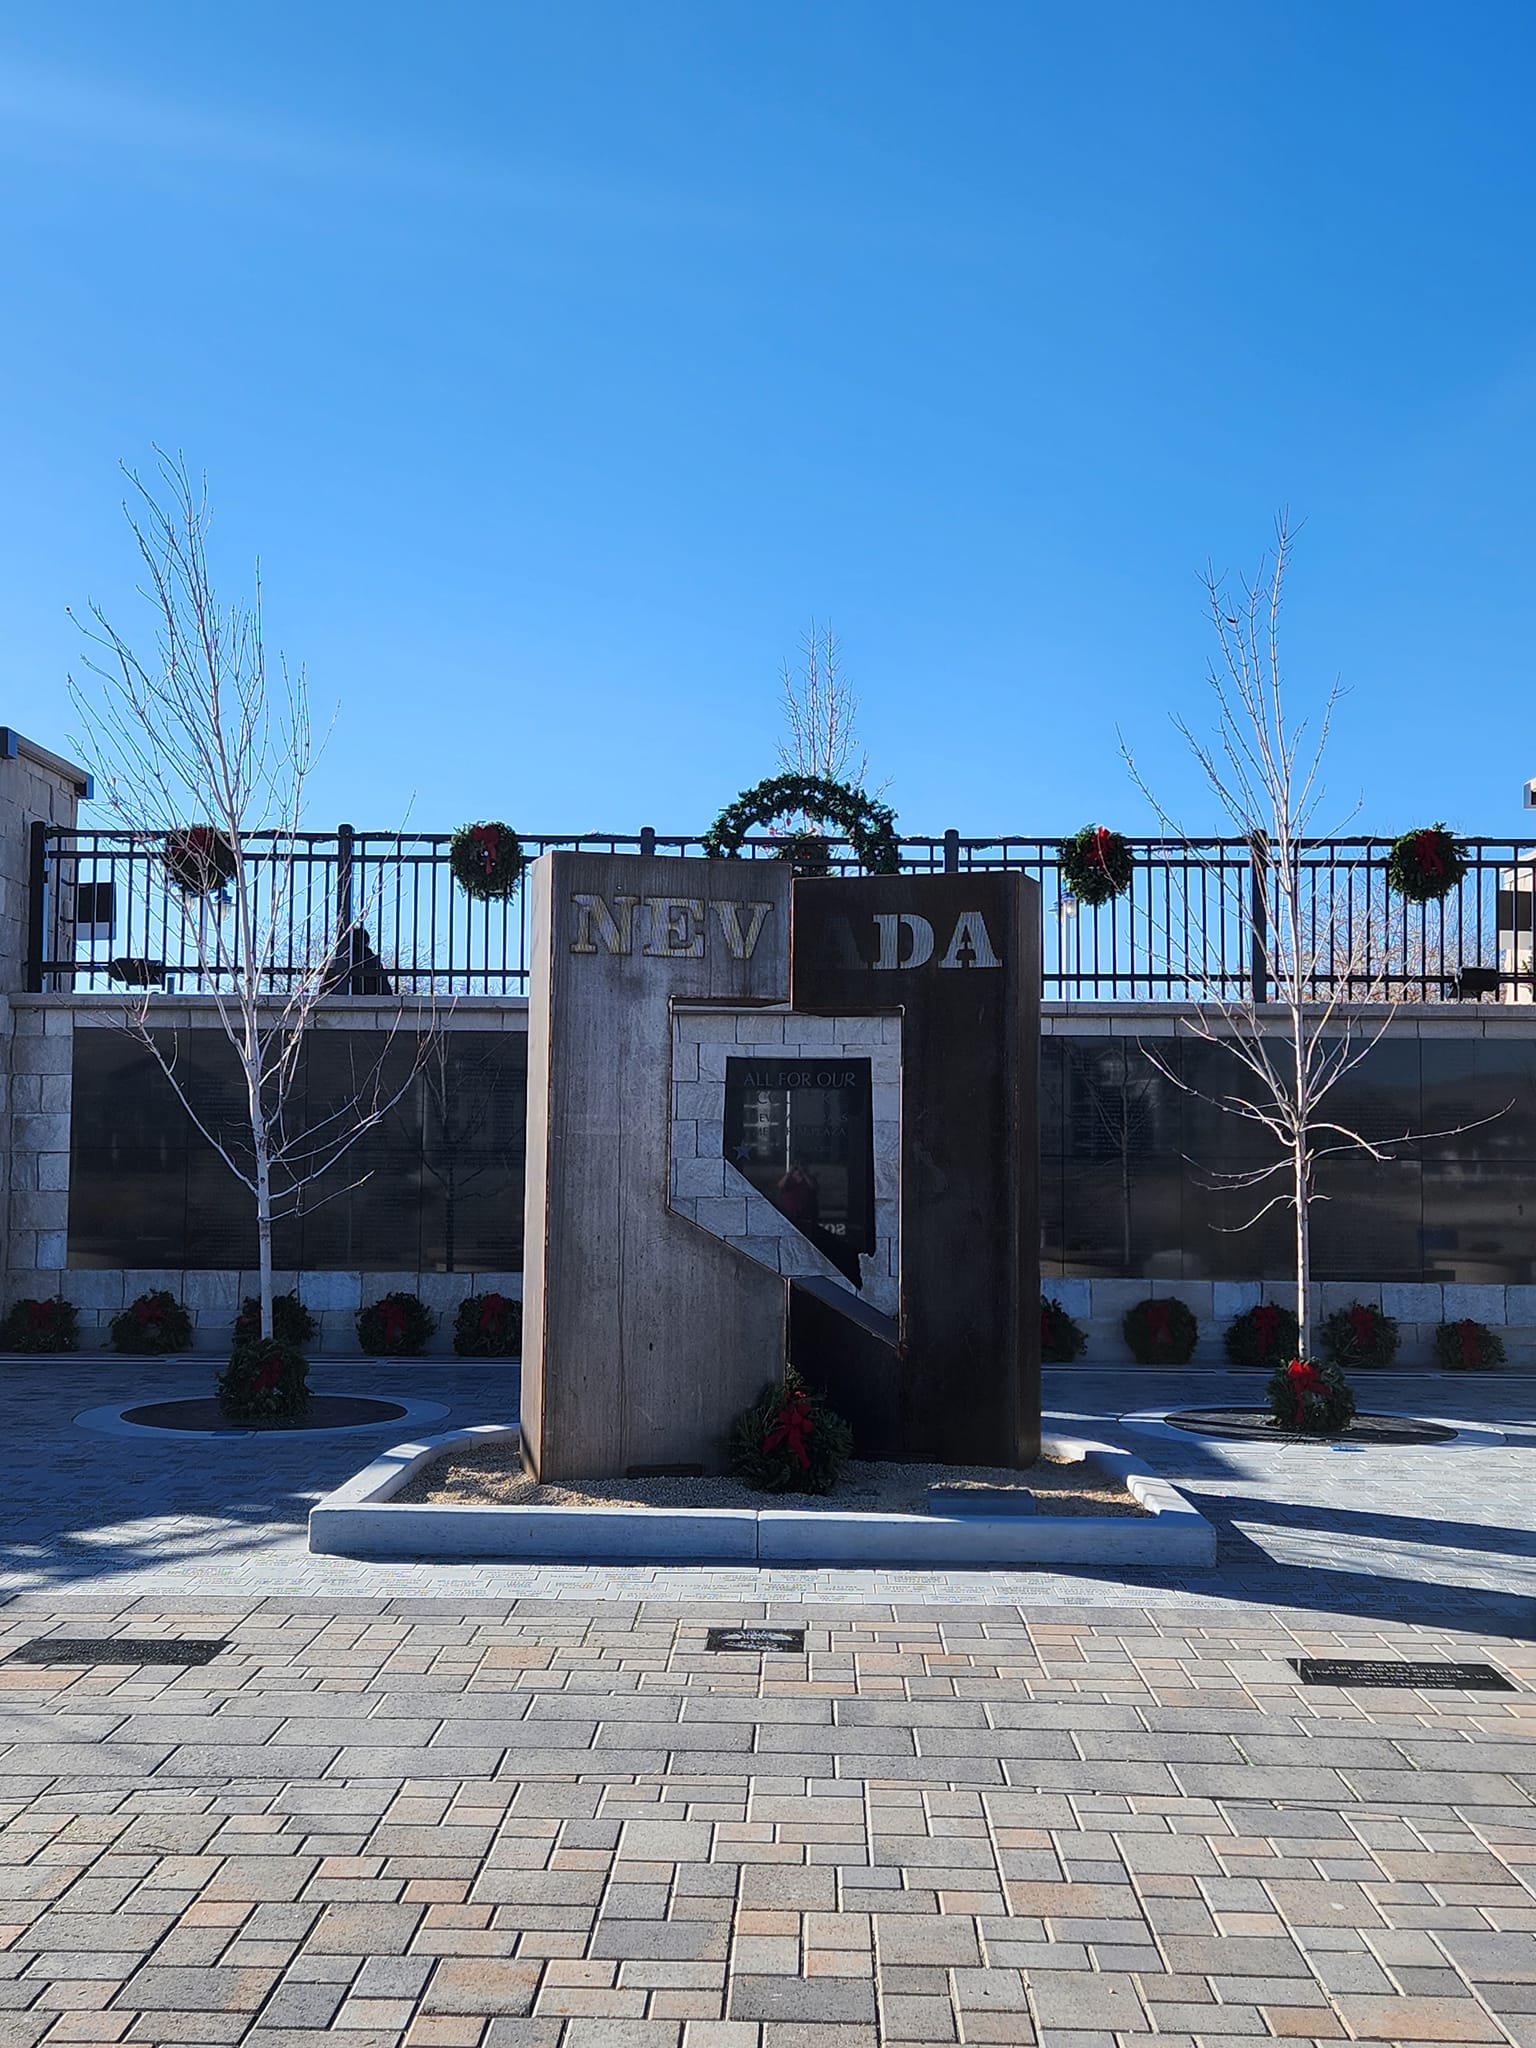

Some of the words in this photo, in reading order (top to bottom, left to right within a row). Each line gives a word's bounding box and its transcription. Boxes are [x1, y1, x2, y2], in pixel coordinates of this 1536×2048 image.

[743, 1072, 773, 1087] ALL
[778, 1071, 812, 1088] FOR
[816, 1071, 856, 1088] OUR
